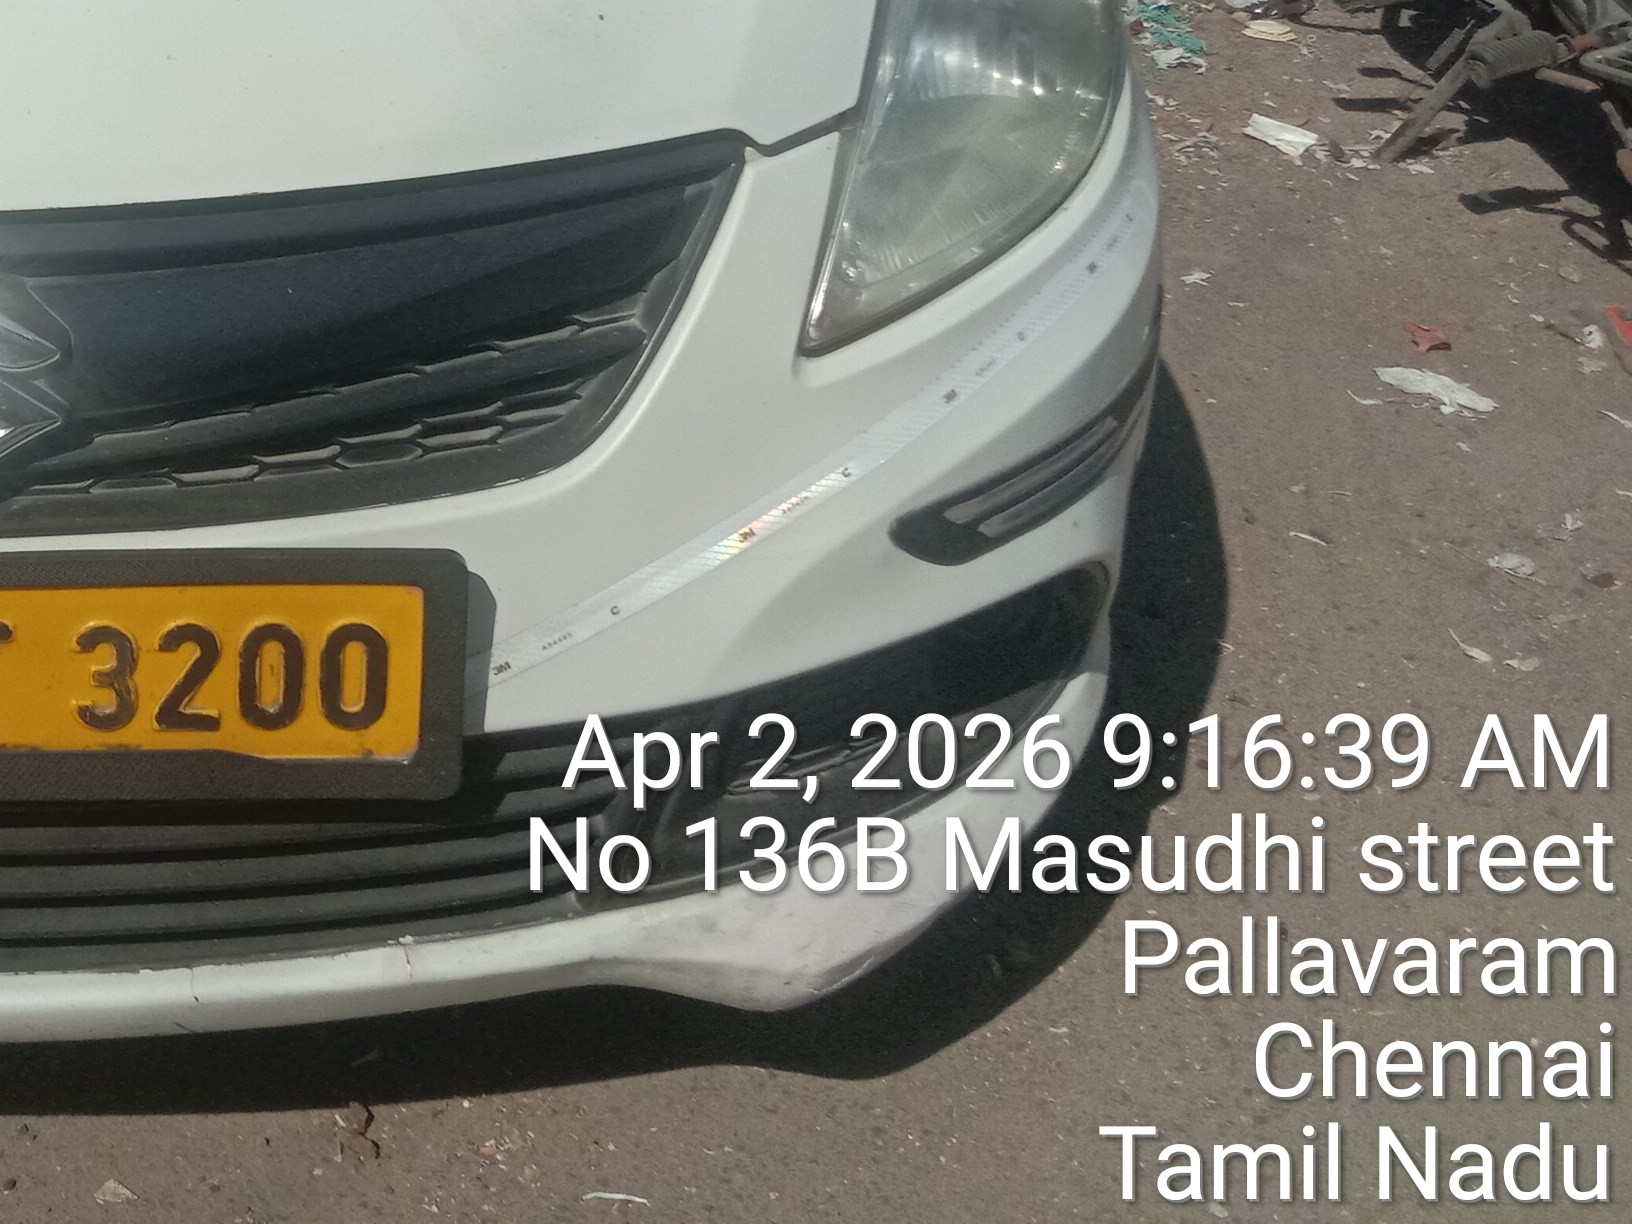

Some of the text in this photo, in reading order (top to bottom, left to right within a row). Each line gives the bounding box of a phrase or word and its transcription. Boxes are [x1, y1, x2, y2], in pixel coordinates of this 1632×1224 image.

[74, 621, 390, 732] 3200
[491, 660, 513, 676] 3M
[609, 605, 620, 616] C
